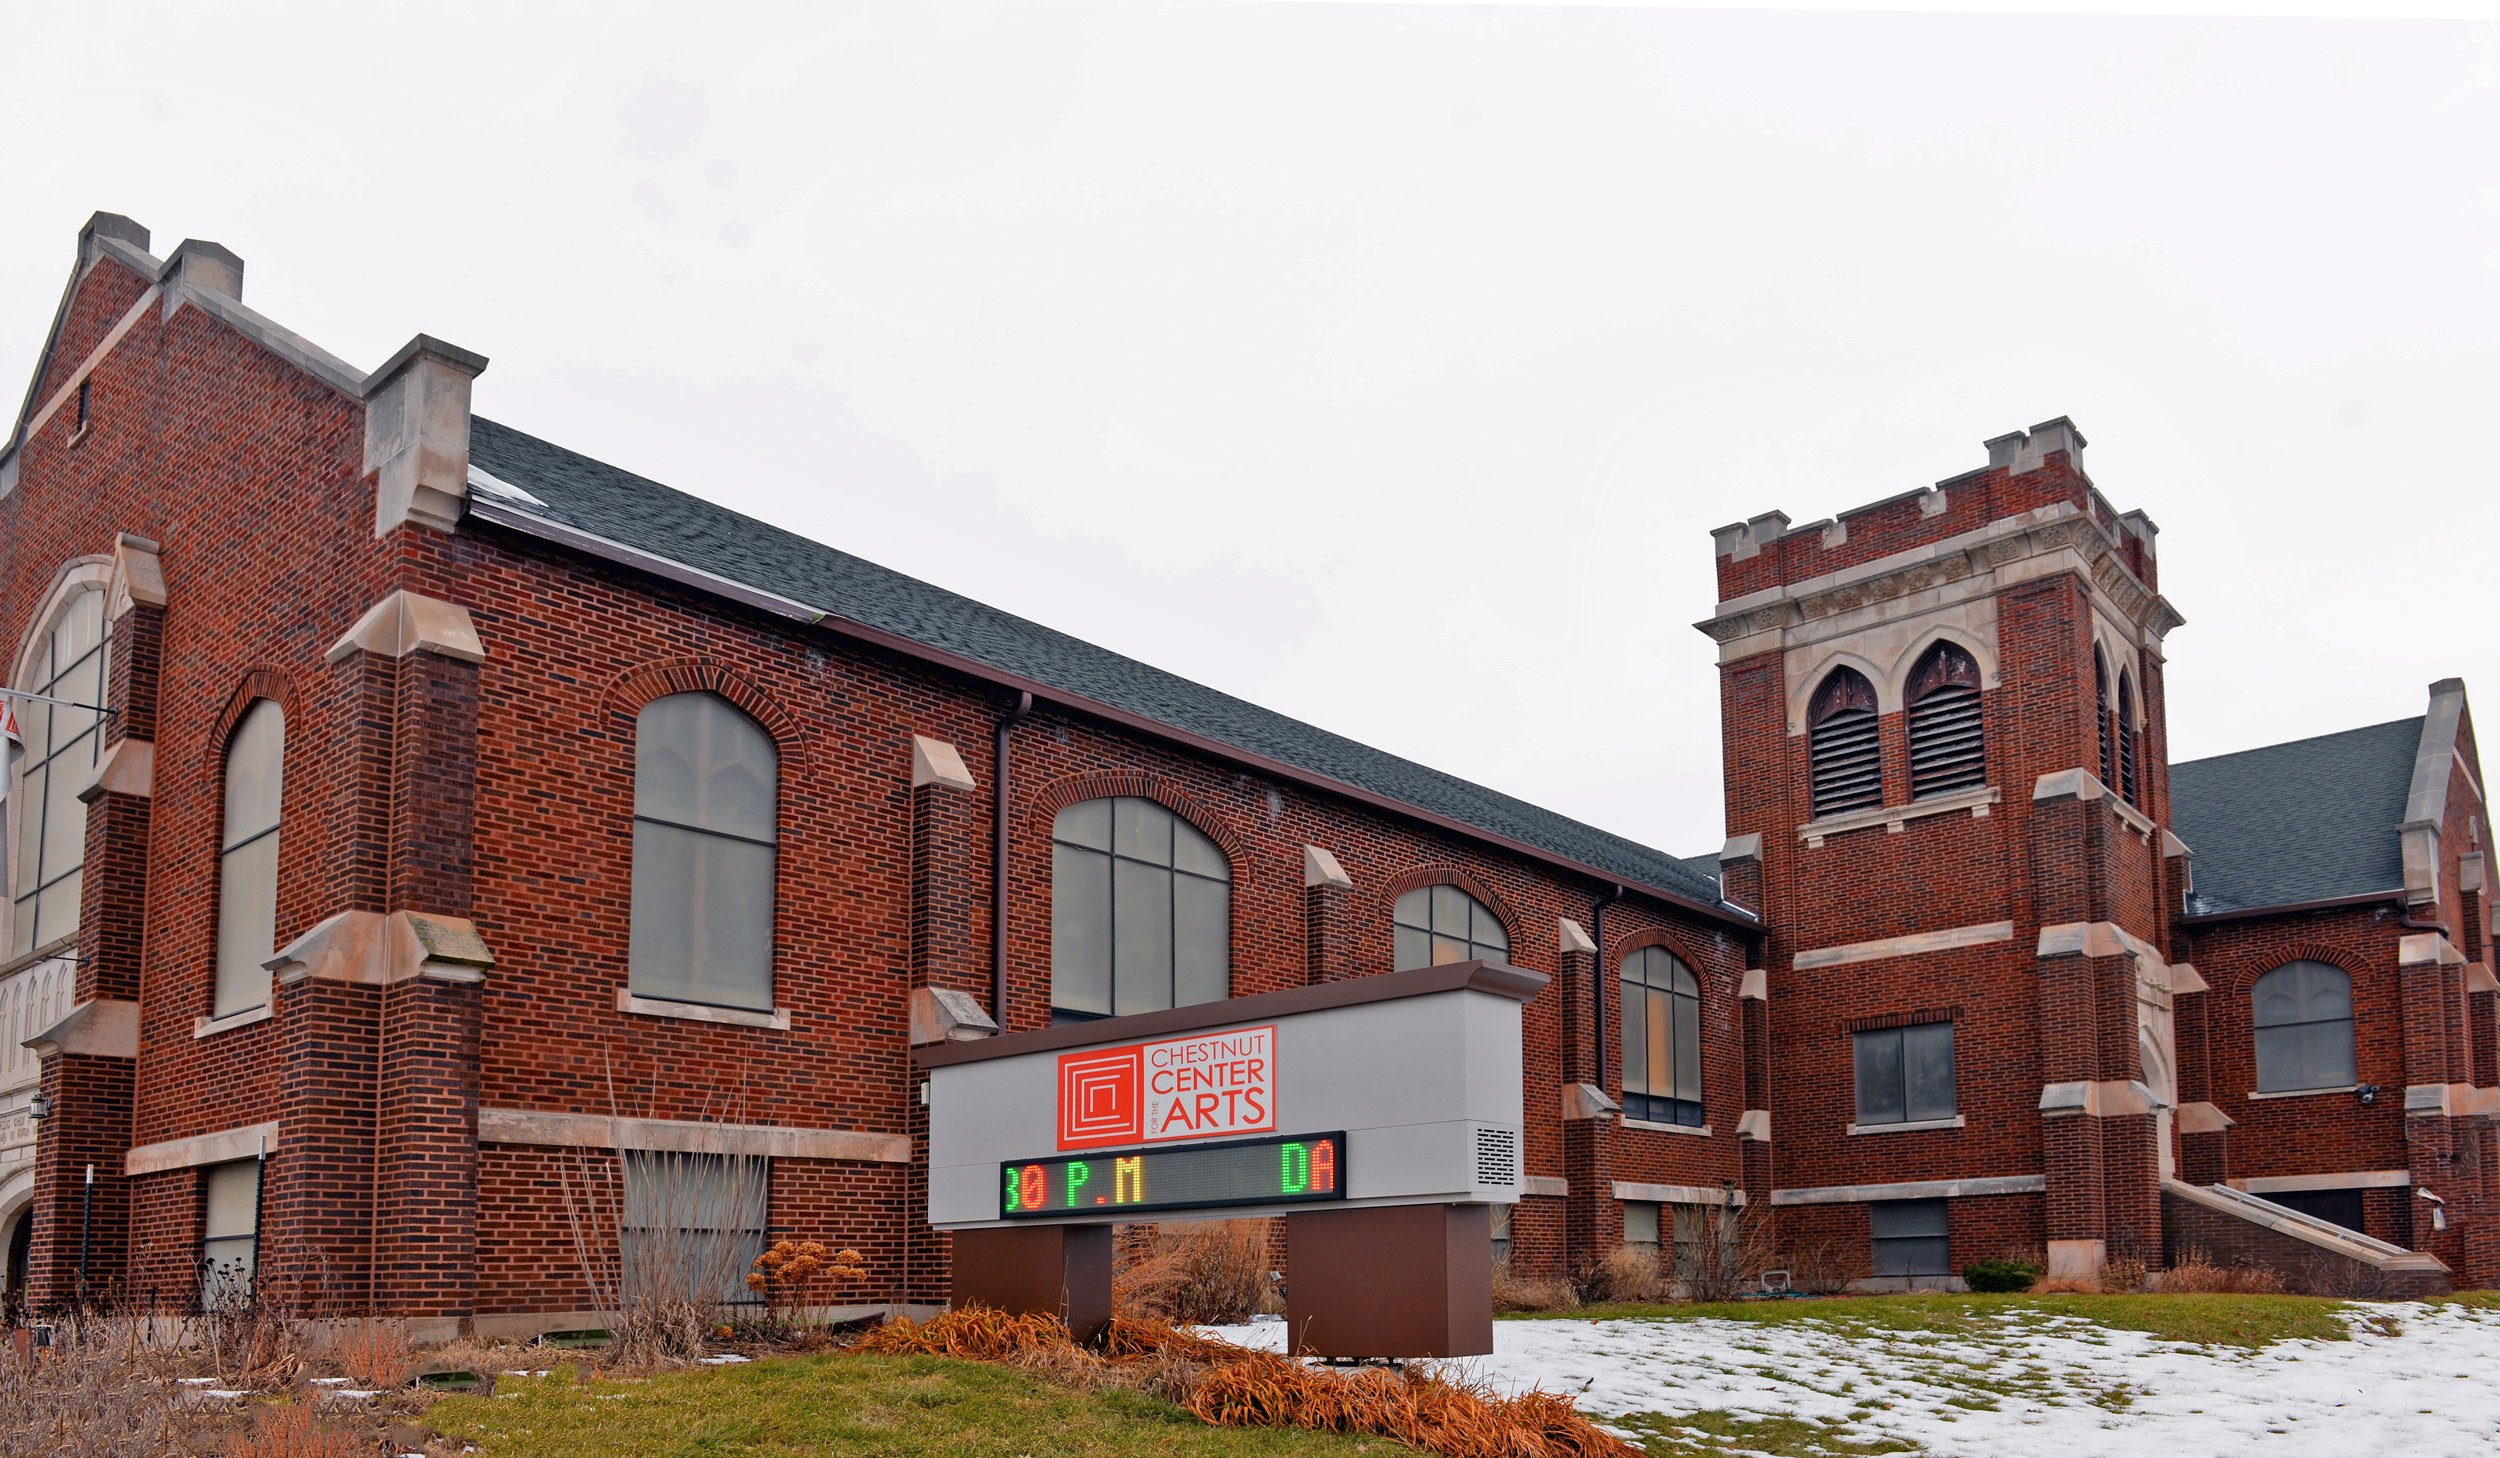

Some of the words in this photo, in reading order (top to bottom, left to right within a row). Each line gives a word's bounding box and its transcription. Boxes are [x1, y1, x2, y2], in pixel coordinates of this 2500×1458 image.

[1151, 1034, 1265, 1068] CHESTNUT
[1151, 1058, 1265, 1095] CENTER
[1151, 1101, 1159, 1116] THE
[1151, 1117, 1159, 1134] FOR
[1160, 1086, 1266, 1133] ARTS
[1281, 1139, 1334, 1193] DA
